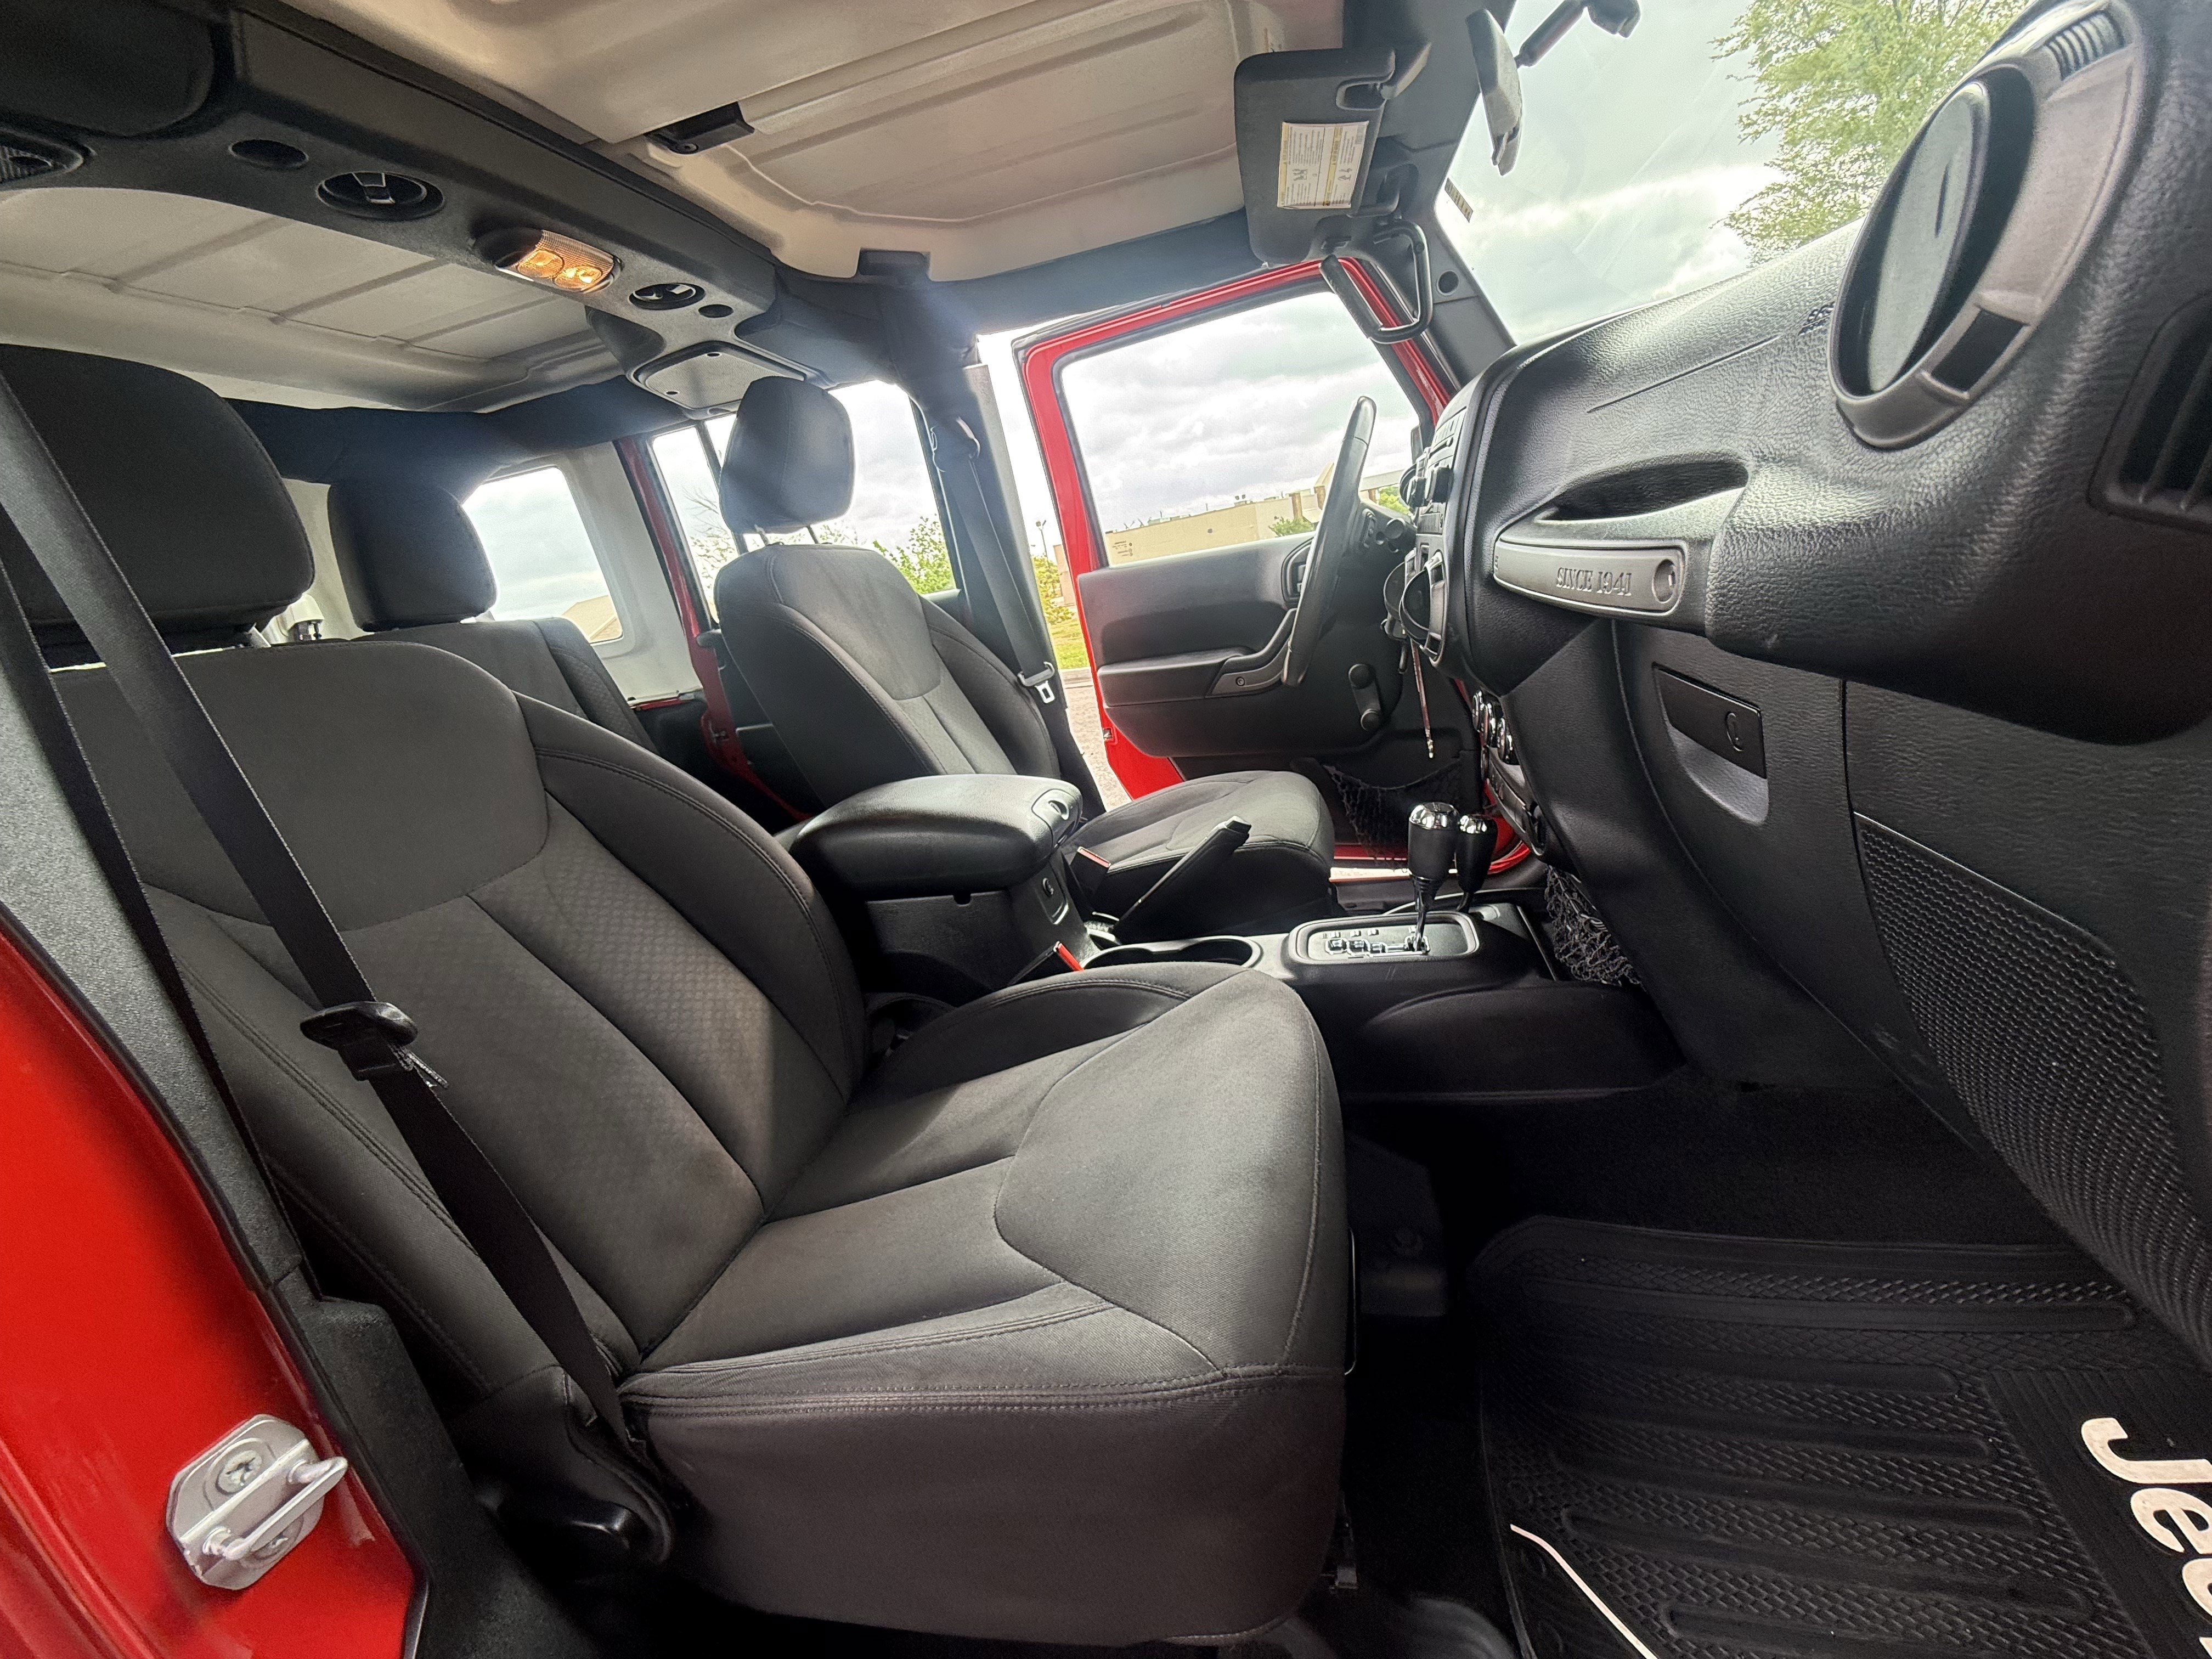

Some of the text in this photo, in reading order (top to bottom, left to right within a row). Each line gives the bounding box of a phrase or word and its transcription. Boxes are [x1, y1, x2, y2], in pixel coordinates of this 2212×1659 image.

[1556, 567, 1632, 596] SINCE 1941
[2081, 1417, 2212, 1659] Je
